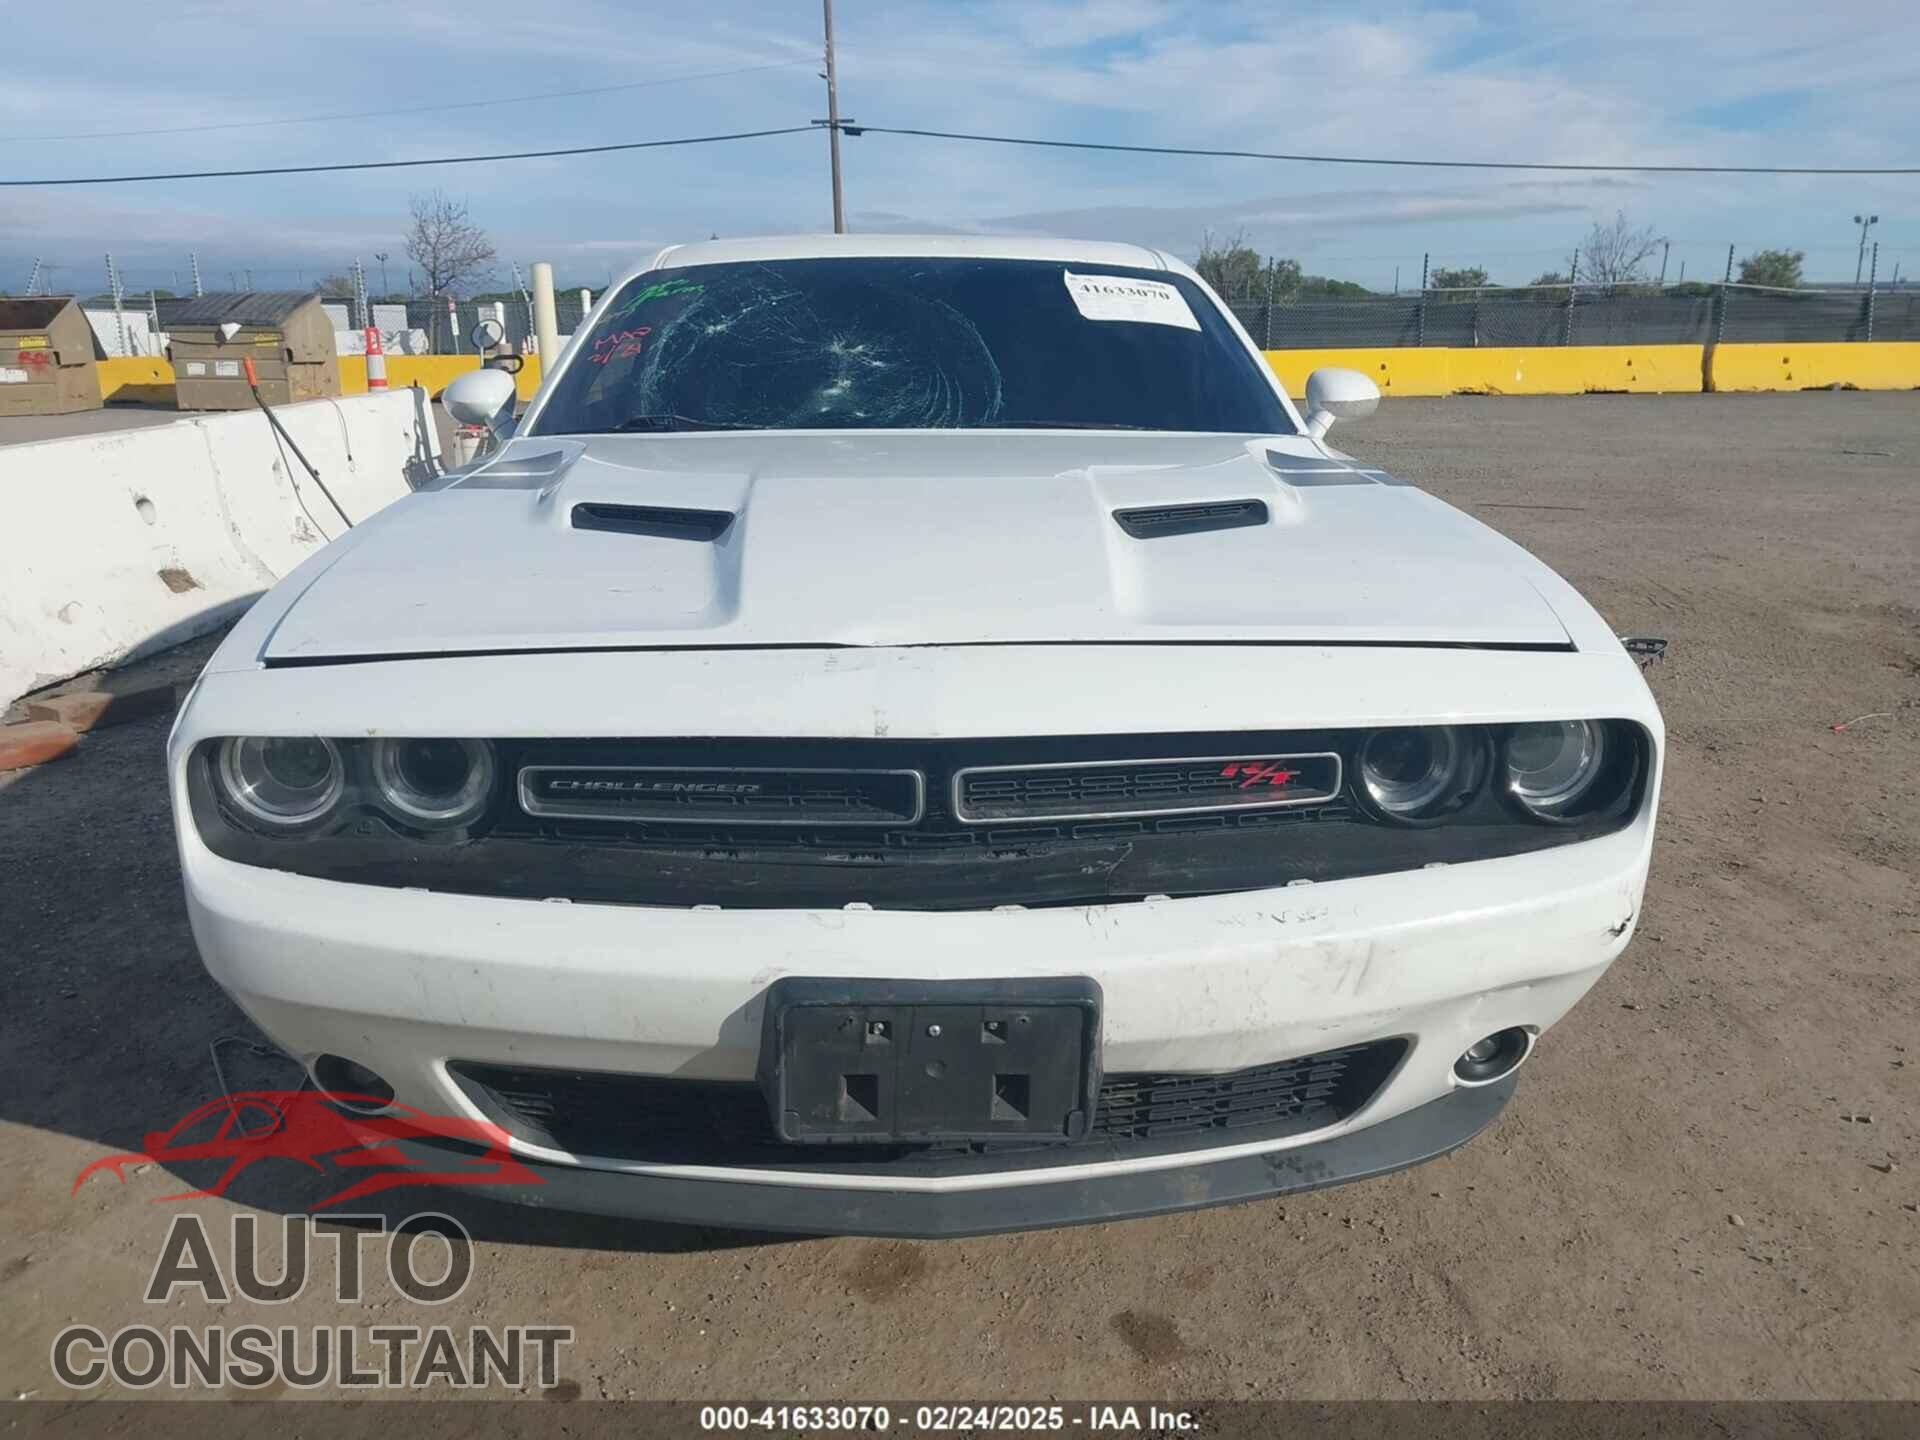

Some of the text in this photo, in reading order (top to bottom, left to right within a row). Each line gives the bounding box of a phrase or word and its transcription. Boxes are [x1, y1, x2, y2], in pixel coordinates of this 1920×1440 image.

[1080, 283, 1170, 301] 41633070
[1219, 760, 1302, 789] R/T
[548, 779, 761, 793] CHALLENGER
